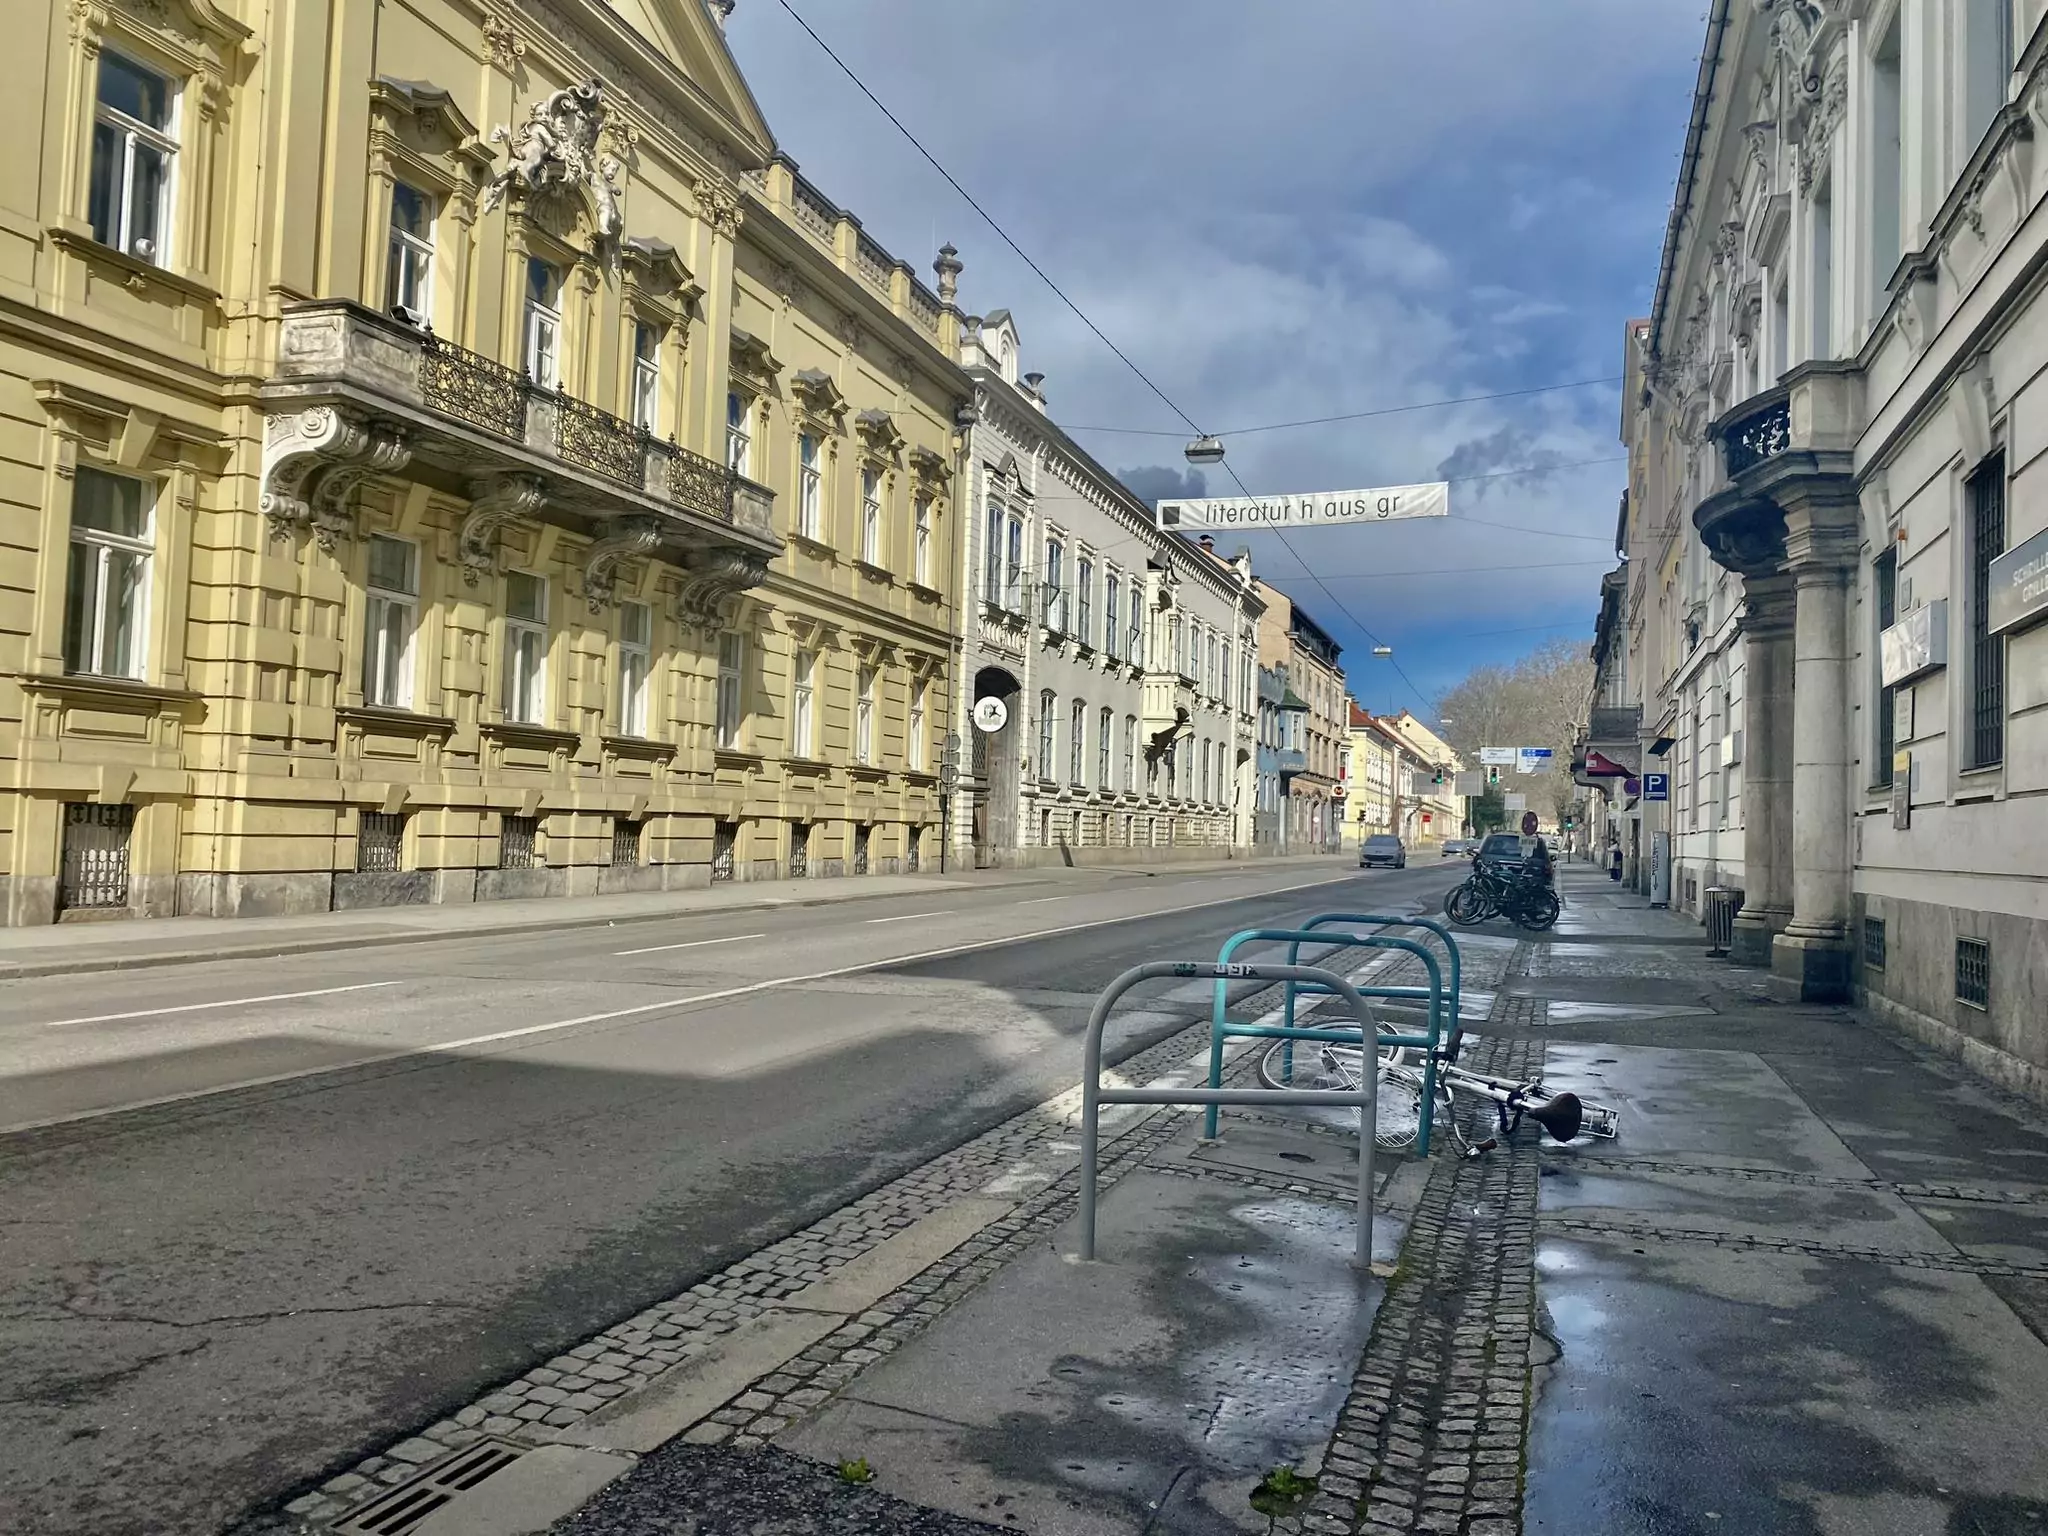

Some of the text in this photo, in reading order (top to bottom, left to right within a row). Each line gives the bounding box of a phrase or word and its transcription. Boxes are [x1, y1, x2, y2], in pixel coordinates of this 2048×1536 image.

[1205, 493, 1402, 523] literatur h aus gr
[1649, 775, 1662, 791] P
